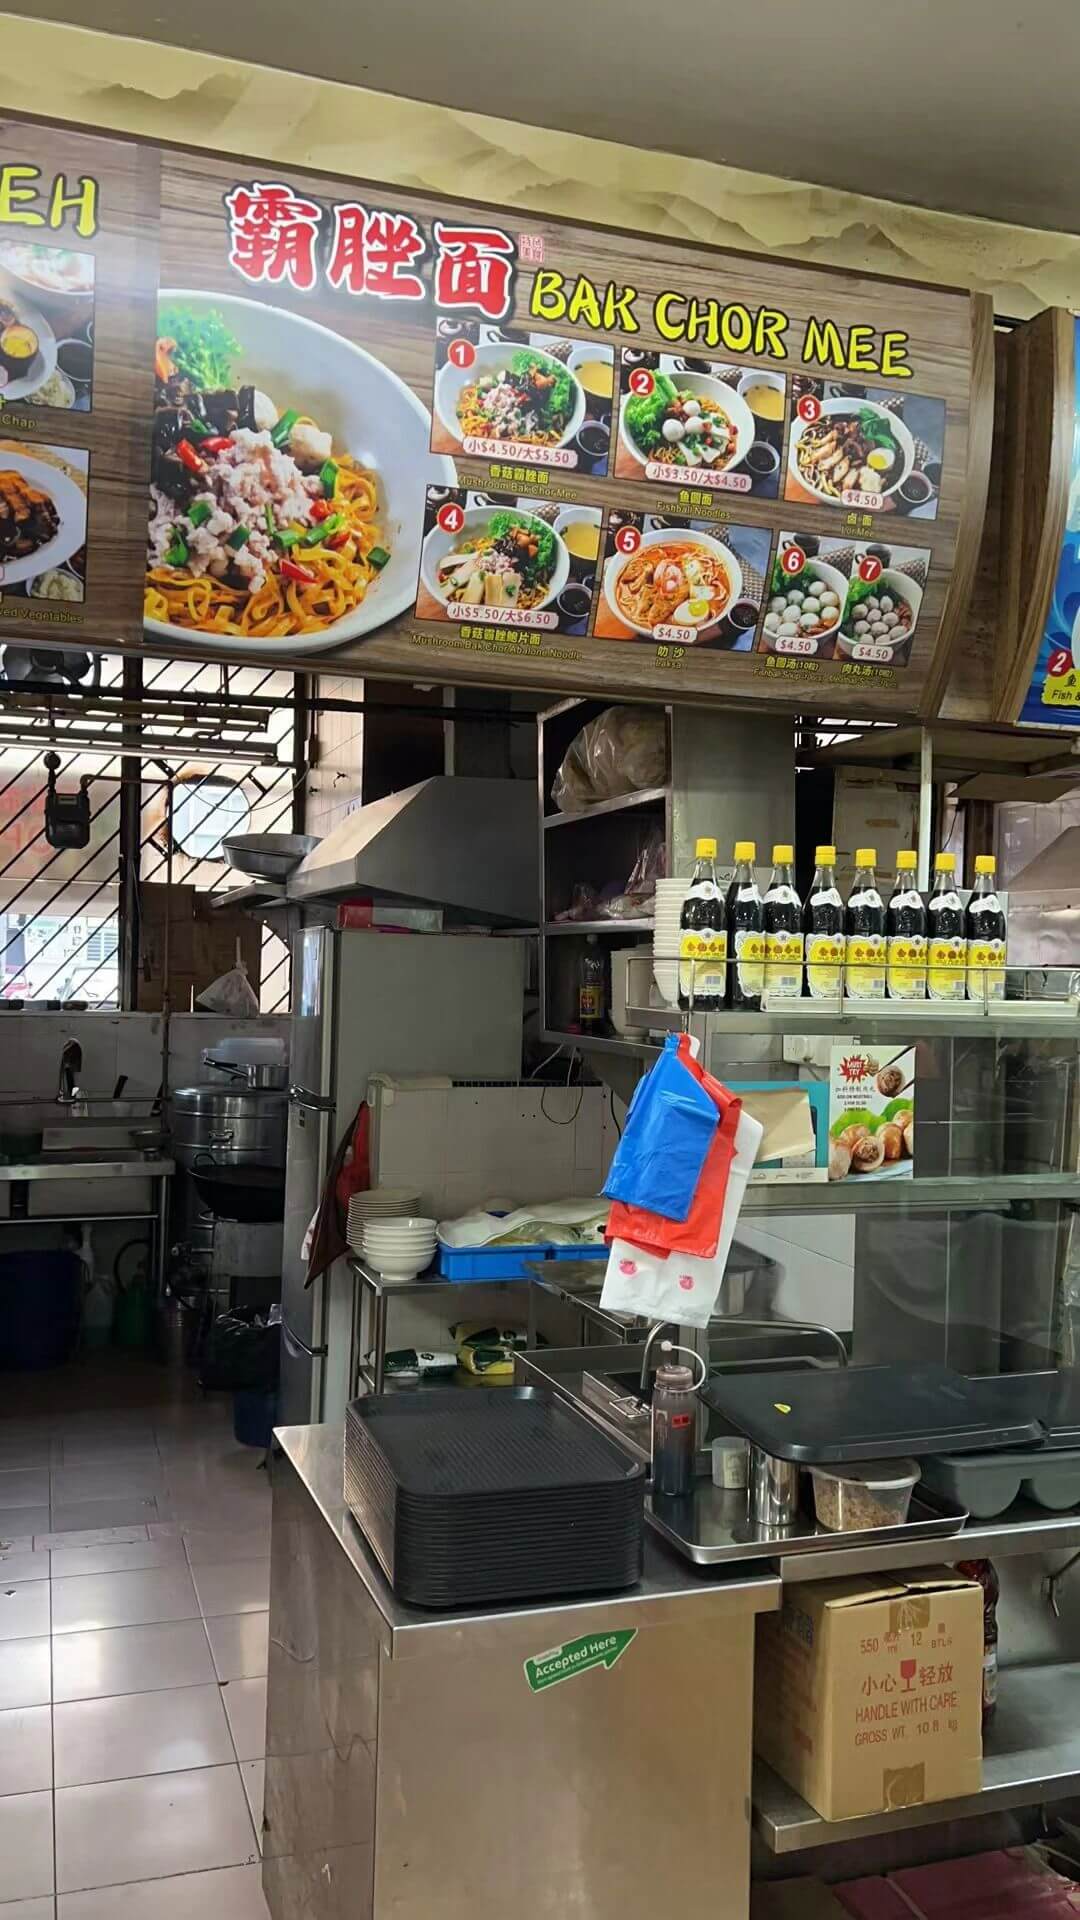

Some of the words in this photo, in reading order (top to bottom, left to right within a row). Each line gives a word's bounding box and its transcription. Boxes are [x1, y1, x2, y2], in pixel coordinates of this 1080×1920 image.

[531, 270, 639, 332] BAK
[653, 292, 789, 359] CHOR
[801, 318, 914, 377] MEE
[455, 345, 466, 366] 1
[634, 372, 651, 393] 2
[802, 398, 818, 420] 3
[847, 491, 878, 506] $4.50
[444, 510, 458, 529] 4
[657, 501, 692, 514] Fishball
[694, 506, 731, 519] Noodles
[623, 532, 636, 551] 5
[787, 552, 800, 571] 6
[865, 560, 878, 580] 7
[21, 607, 85, 624] Vegetables
[453, 605, 551, 625] 小$5.50/大$6.50
[658, 627, 690, 640] $4.50
[780, 640, 811, 652] $4.50
[859, 647, 889, 660] $4.50
[1052, 651, 1067, 673] 2
[1052, 689, 1073, 701] Fish
[535, 1646, 588, 1679] Accepted
[589, 1636, 617, 1655] Here
[862, 1673, 897, 1697] 小心
[919, 1661, 954, 1687] 轻放
[855, 1702, 899, 1723] HANDLE
[900, 1697, 928, 1717] WITH
[929, 1690, 958, 1711] CARE
[854, 1729, 888, 1747] GROSS
